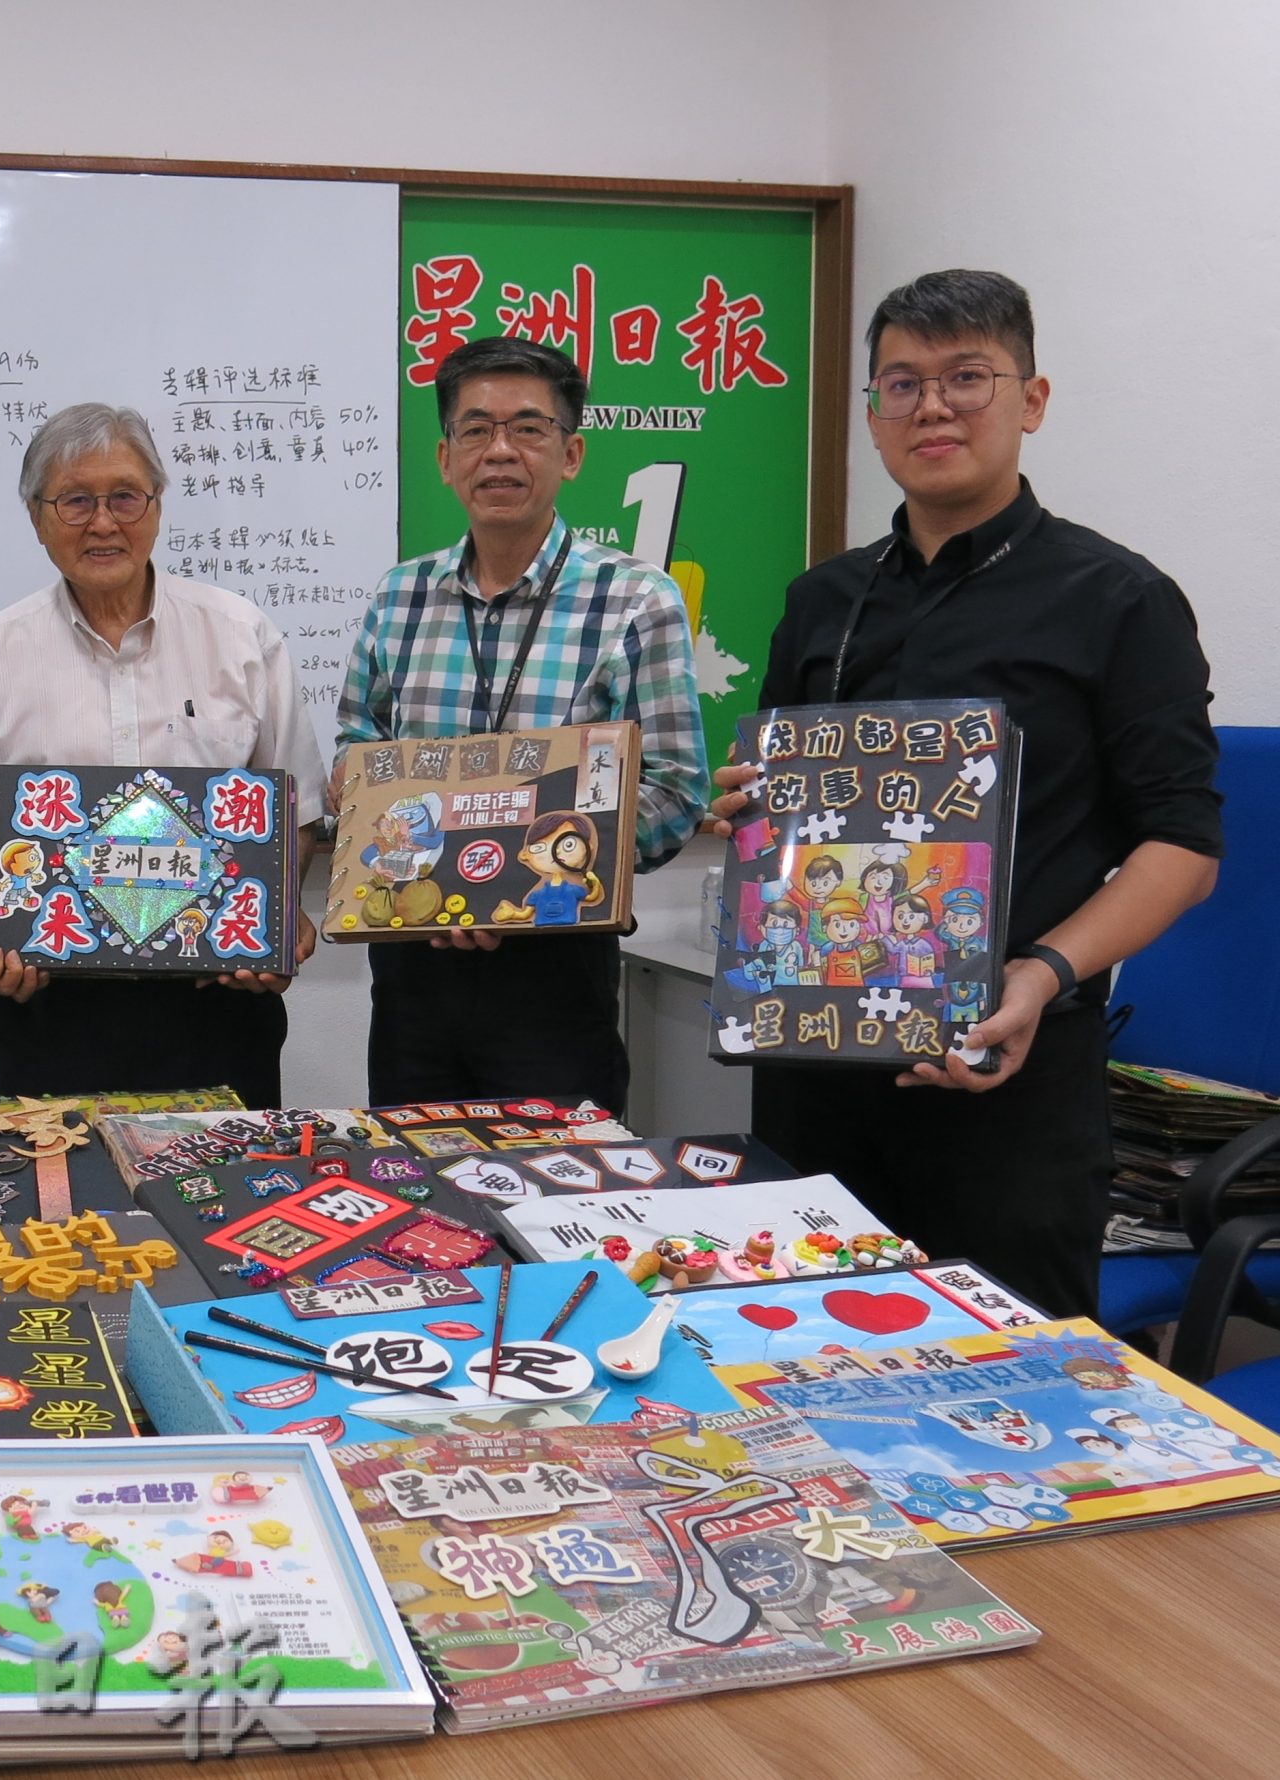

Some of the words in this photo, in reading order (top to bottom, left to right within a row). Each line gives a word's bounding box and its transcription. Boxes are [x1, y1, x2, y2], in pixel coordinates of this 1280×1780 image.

[407, 255, 789, 394] 星洲日報
[339, 404, 379, 425] 50%
[622, 408, 706, 432] DAILY
[342, 436, 379, 457] 40%
[760, 710, 997, 762] 我们都是有
[451, 789, 531, 813] 防范诈骗
[768, 767, 983, 821] 故事的人
[90, 845, 198, 878] 星洲日報
[292, 1274, 473, 1311] 星洲日報
[389, 1464, 601, 1513] 星洲日報
